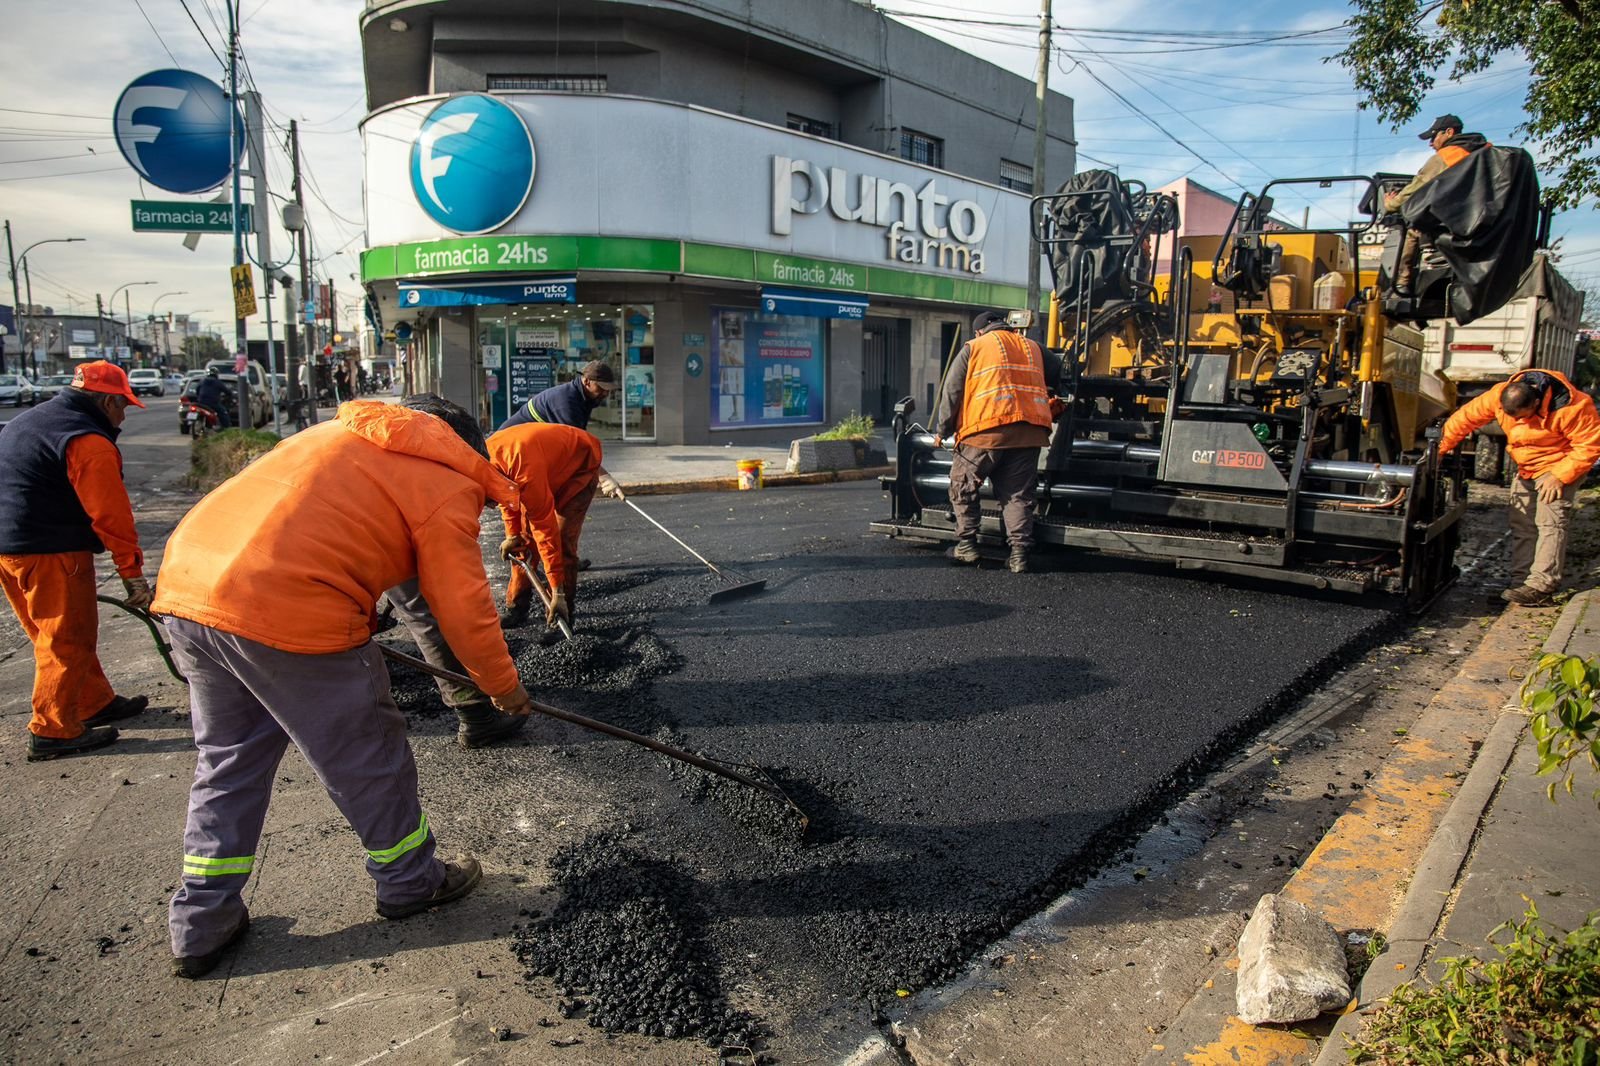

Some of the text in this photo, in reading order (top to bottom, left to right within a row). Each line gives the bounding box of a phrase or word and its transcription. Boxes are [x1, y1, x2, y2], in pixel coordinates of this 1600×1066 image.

[772, 154, 987, 245] punto
[135, 208, 204, 224] farmacia
[414, 241, 548, 269] farmacia 24hs
[886, 221, 985, 274] farma
[773, 259, 855, 287] farmacia 24hs
[524, 285, 567, 296] punto
[838, 305, 862, 314] punto
[512, 395, 519, 404] 3
[1192, 450, 1264, 467] CAT AP500
